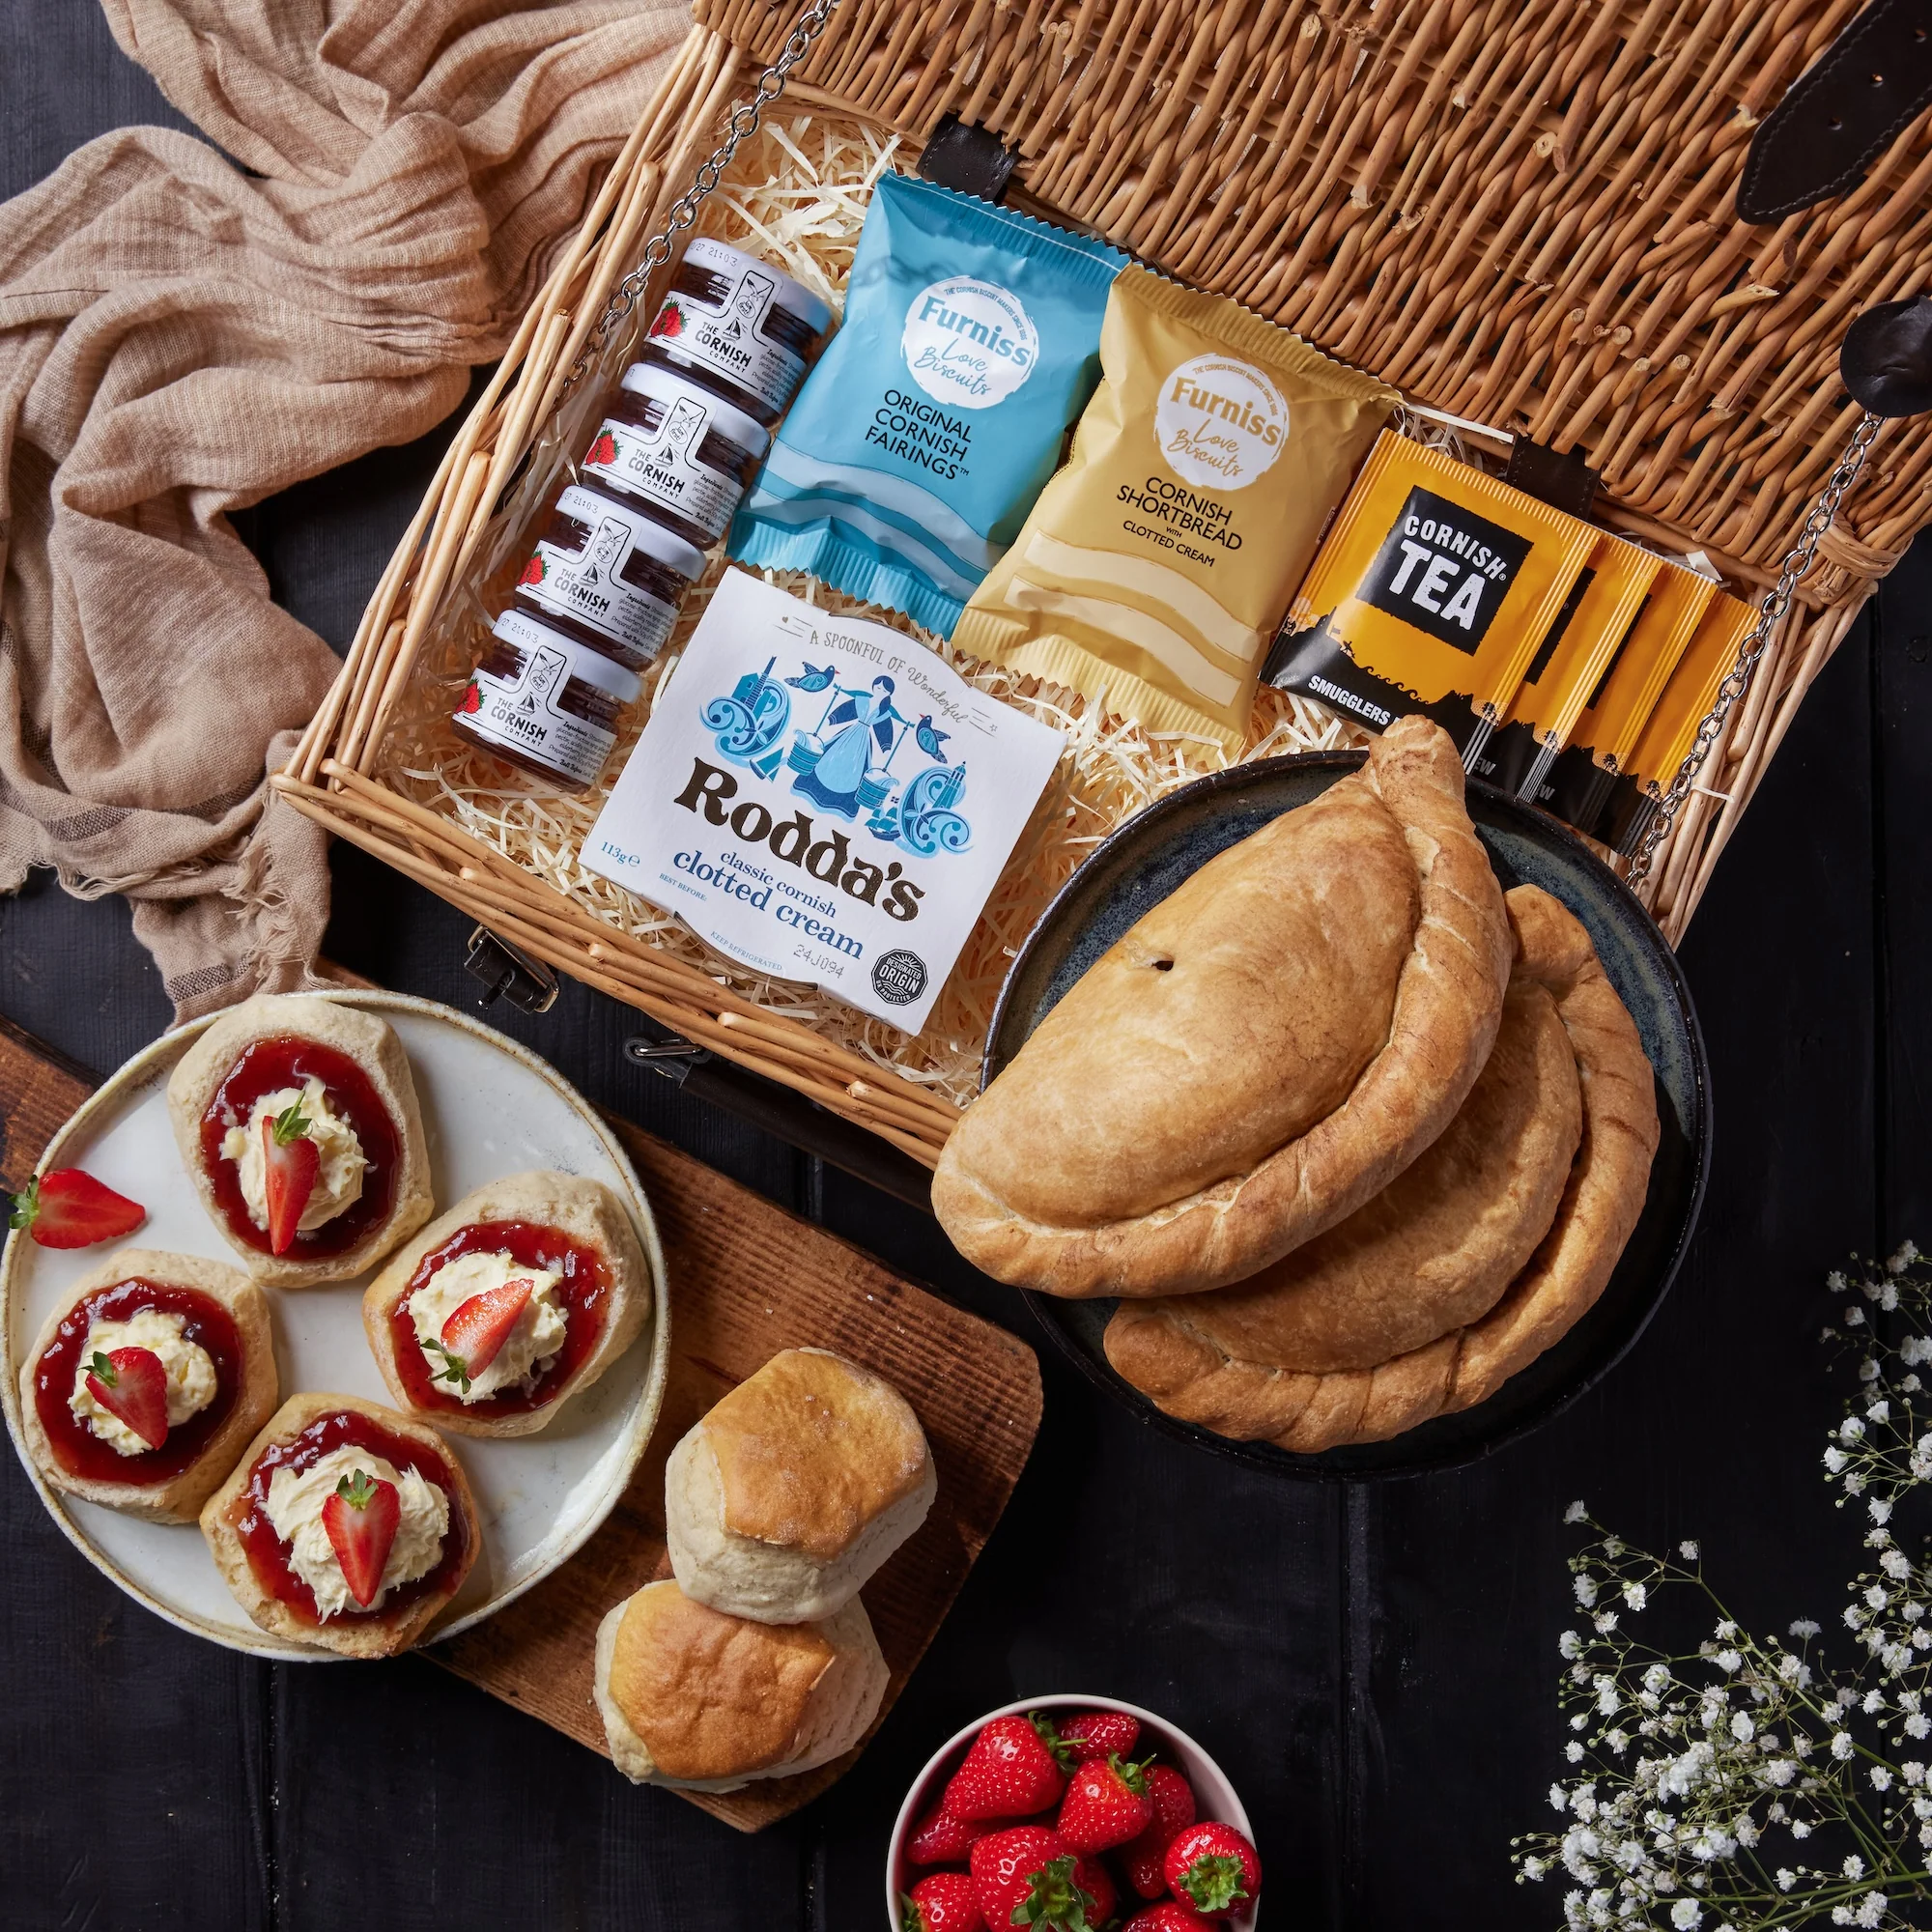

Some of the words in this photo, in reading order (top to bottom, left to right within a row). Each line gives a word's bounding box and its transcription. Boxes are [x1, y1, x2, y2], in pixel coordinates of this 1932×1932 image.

[708, 246, 738, 268] 21:03
[979, 287, 999, 302] BISCUIT
[997, 297, 1015, 317] MAKERS
[702, 321, 719, 335] THE
[919, 295, 1031, 366] Furniss
[695, 329, 753, 368] CORNISH
[709, 351, 746, 373] COMPANY
[941, 338, 988, 372] Love
[914, 346, 991, 395] Biscuits
[884, 389, 972, 442] ORIGINAL
[1169, 376, 1281, 446] Furniss
[875, 408, 968, 462] CORNISH
[1167, 428, 1243, 477] Biscuits
[1193, 418, 1240, 453] Love
[635, 448, 652, 462] THE
[628, 457, 685, 494] CORNISH
[642, 477, 680, 499] COMPANY
[573, 493, 599, 514] 21:03
[1117, 485, 1242, 551] SHORTBREAD
[1146, 476, 1233, 526] CORNISH
[1122, 520, 1174, 549] CLOTTED
[1176, 543, 1215, 567] CREAM
[560, 568, 577, 581] THE
[1388, 538, 1486, 631] TEA
[554, 576, 611, 612] CORNISH
[567, 596, 605, 618] COMPANY
[511, 622, 539, 644] 21:03
[810, 630, 819, 644] A
[824, 632, 885, 666] SPOONFUL
[888, 656, 906, 674] OF
[907, 667, 970, 724] Wonderful
[497, 696, 514, 710] THE
[1307, 674, 1390, 726] SMUGGLERS
[490, 705, 548, 741] CORNISH
[504, 724, 542, 747] COMPANY
[673, 756, 927, 922] Rodda's
[659, 873, 678, 886] BEST
[677, 882, 707, 901] BEFORE:
[720, 850, 775, 886] classic
[776, 880, 838, 919] cornish
[673, 850, 774, 912] clotted
[775, 902, 865, 961] cream
[711, 930, 728, 947] KEEP
[728, 943, 782, 971] REFRIGERATED
[886, 957, 922, 980] DESIGNATED
[879, 964, 920, 993] ORIGIN
[880, 988, 910, 1002] PROTECTED
